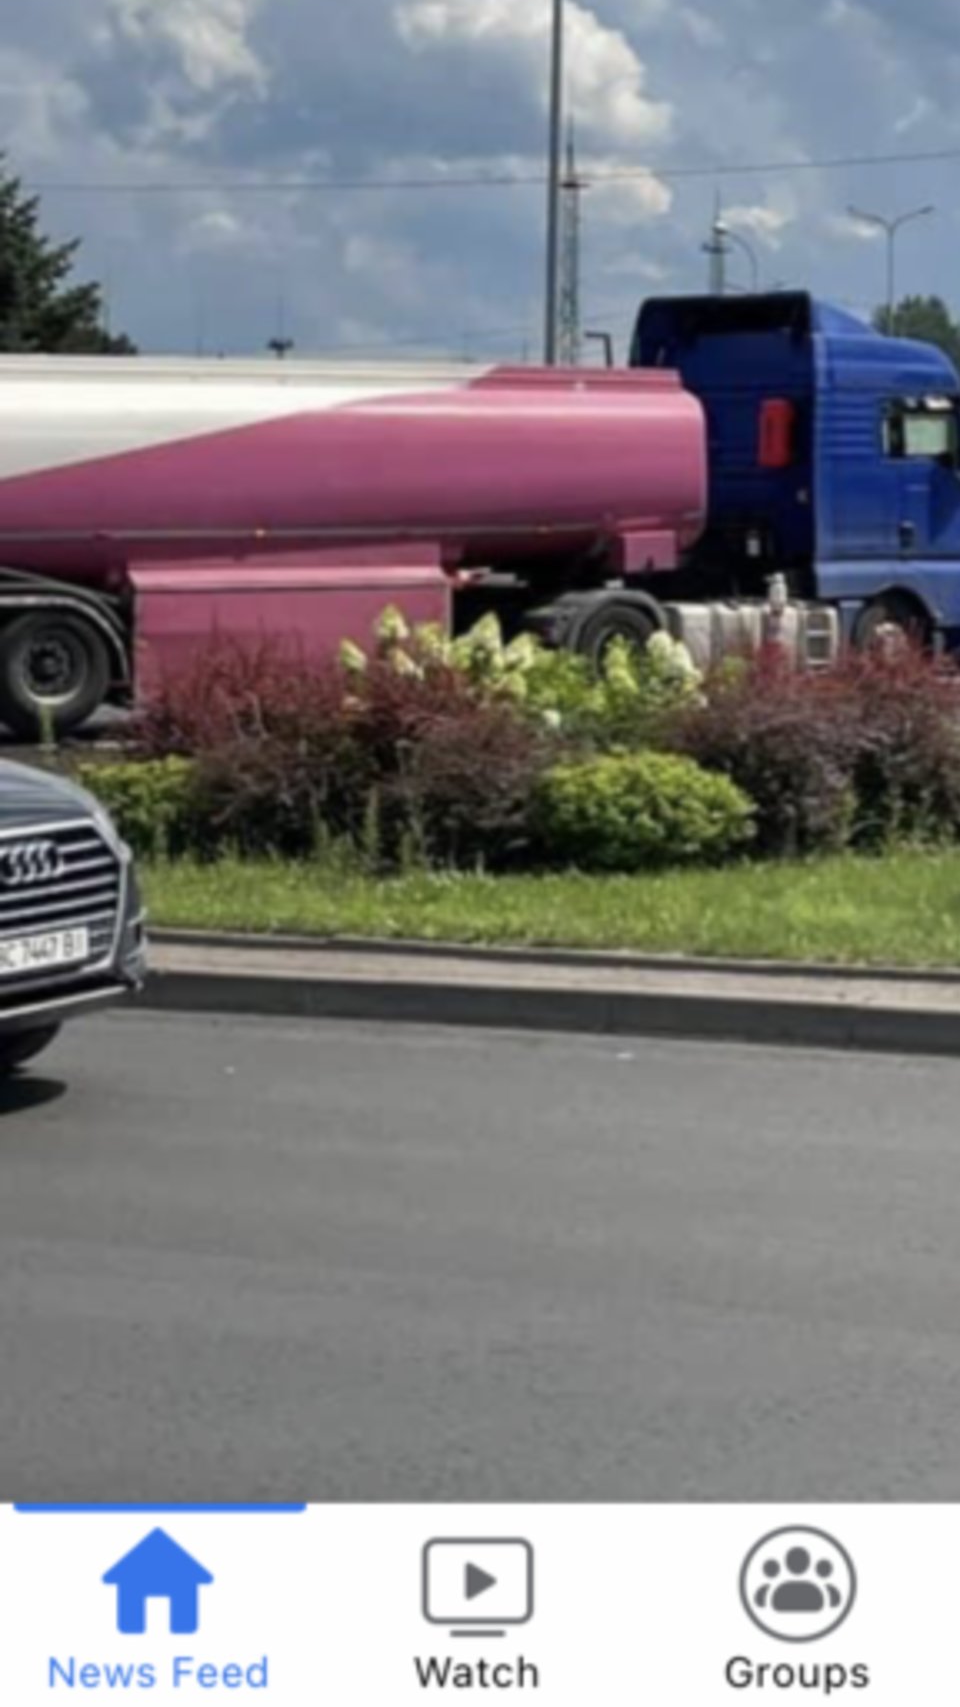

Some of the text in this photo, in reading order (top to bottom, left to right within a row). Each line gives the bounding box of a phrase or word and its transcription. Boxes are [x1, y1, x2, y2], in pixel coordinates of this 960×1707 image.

[48, 1655, 269, 1689] News Feed
[412, 1654, 540, 1689] Watch
[723, 1655, 871, 1697] Groups
